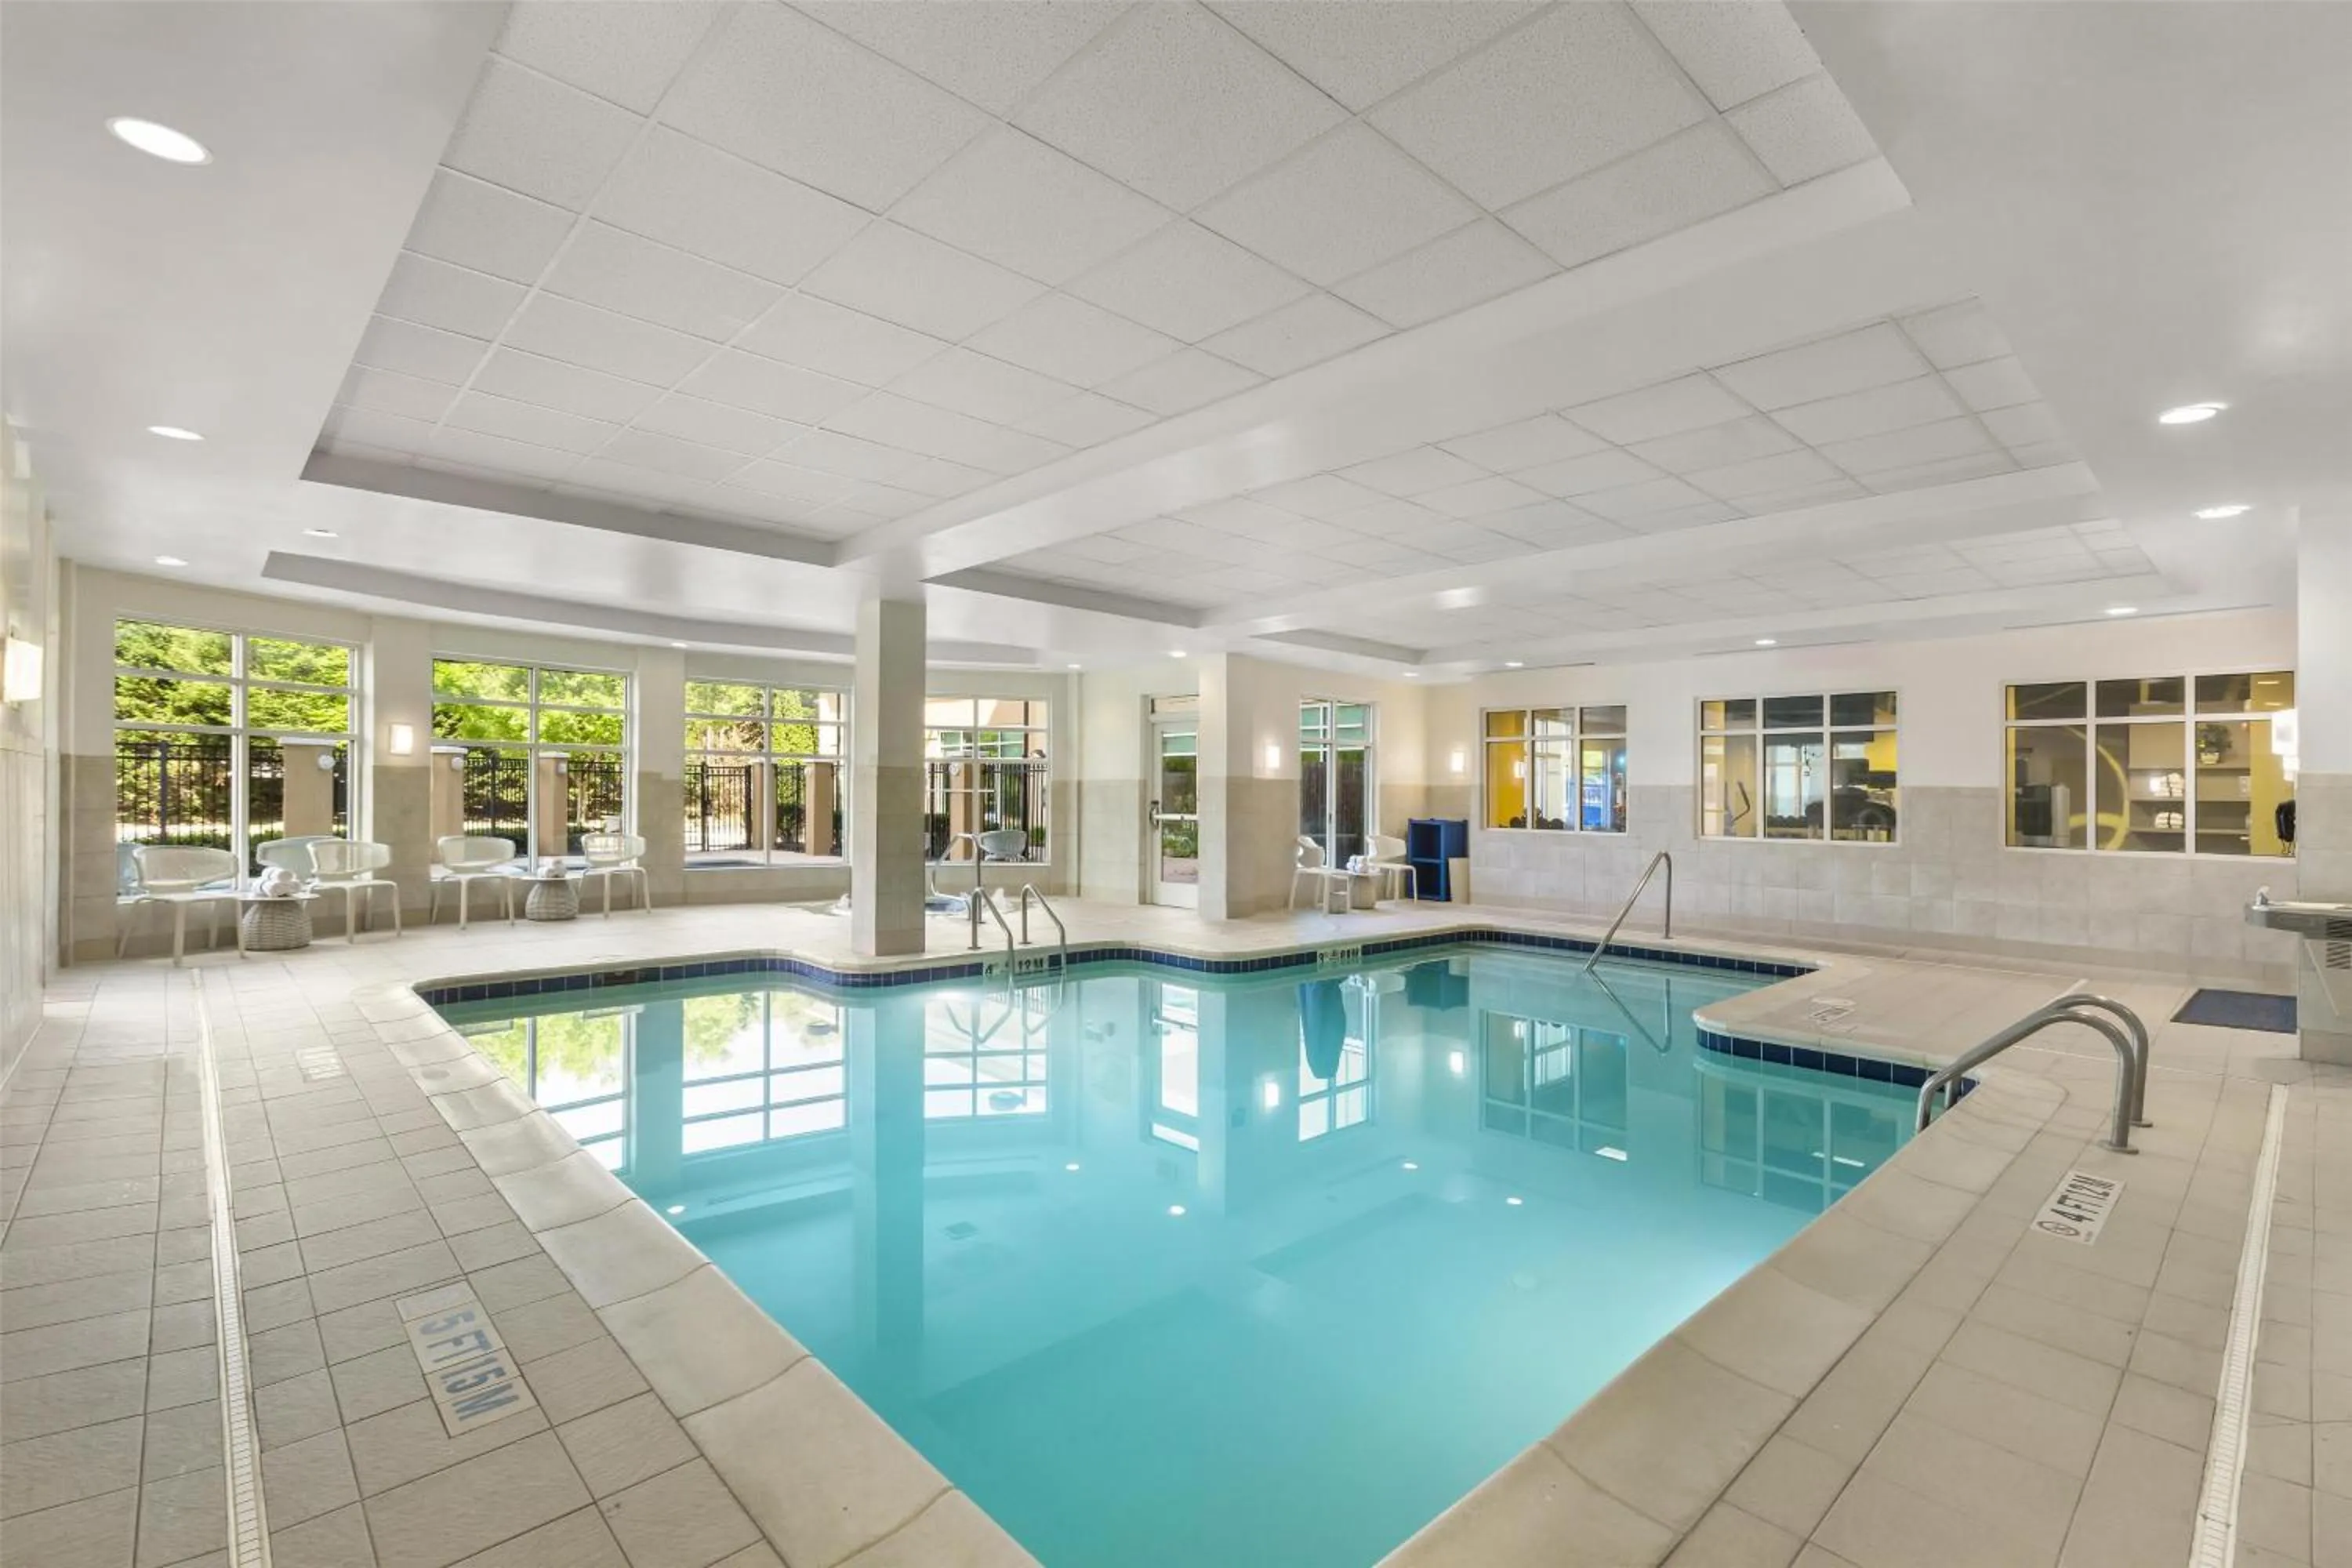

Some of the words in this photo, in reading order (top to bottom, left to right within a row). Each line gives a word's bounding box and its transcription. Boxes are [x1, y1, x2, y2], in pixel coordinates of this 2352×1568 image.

[2056, 1194, 2103, 1214] FT
[419, 1311, 476, 1335] 5
[426, 1330, 492, 1363] FT
